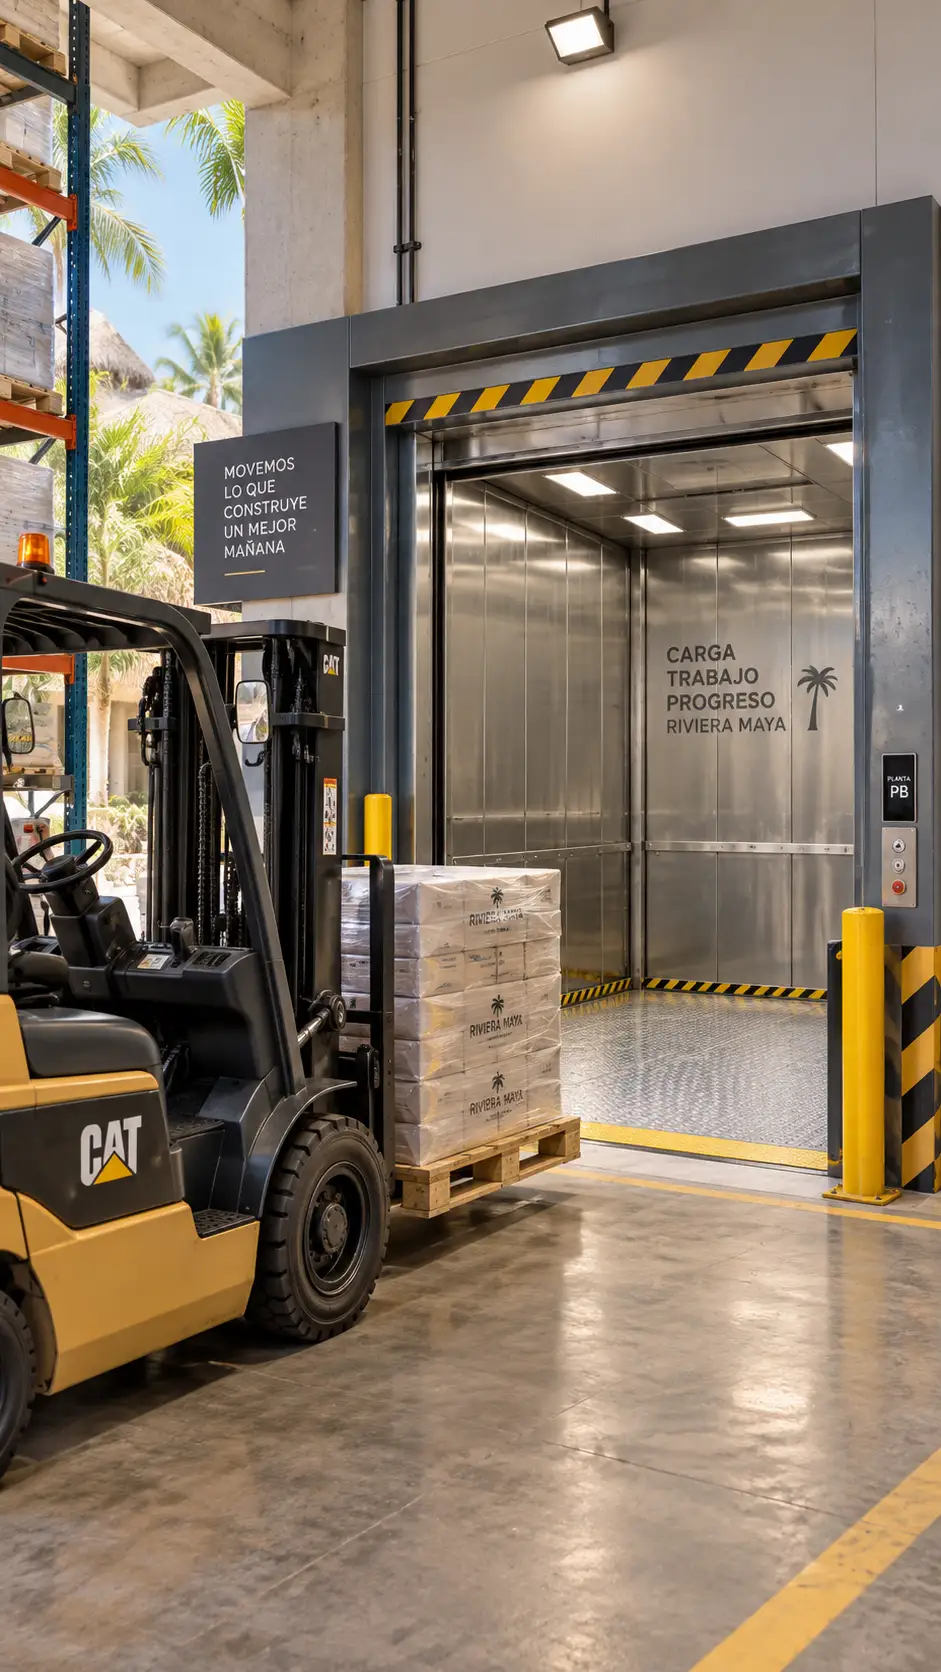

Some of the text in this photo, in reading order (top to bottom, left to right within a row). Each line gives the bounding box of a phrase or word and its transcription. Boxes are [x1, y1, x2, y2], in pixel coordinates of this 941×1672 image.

[224, 457, 295, 479] MOVEMOS
[224, 479, 276, 499] LO QUE
[224, 496, 307, 519] CONSTRUYE
[224, 518, 296, 539] UN MEJOR
[666, 643, 736, 663] CARGA
[323, 654, 340, 676] CAT
[667, 667, 759, 687] TRABAJO
[667, 691, 776, 712] PROGRESO
[667, 716, 786, 734] RIVIERA MAYA
[887, 775, 911, 783] PLANTA
[890, 785, 909, 798] PB
[469, 1019, 501, 1038] RIVIERA
[80, 1115, 142, 1187] CAT
